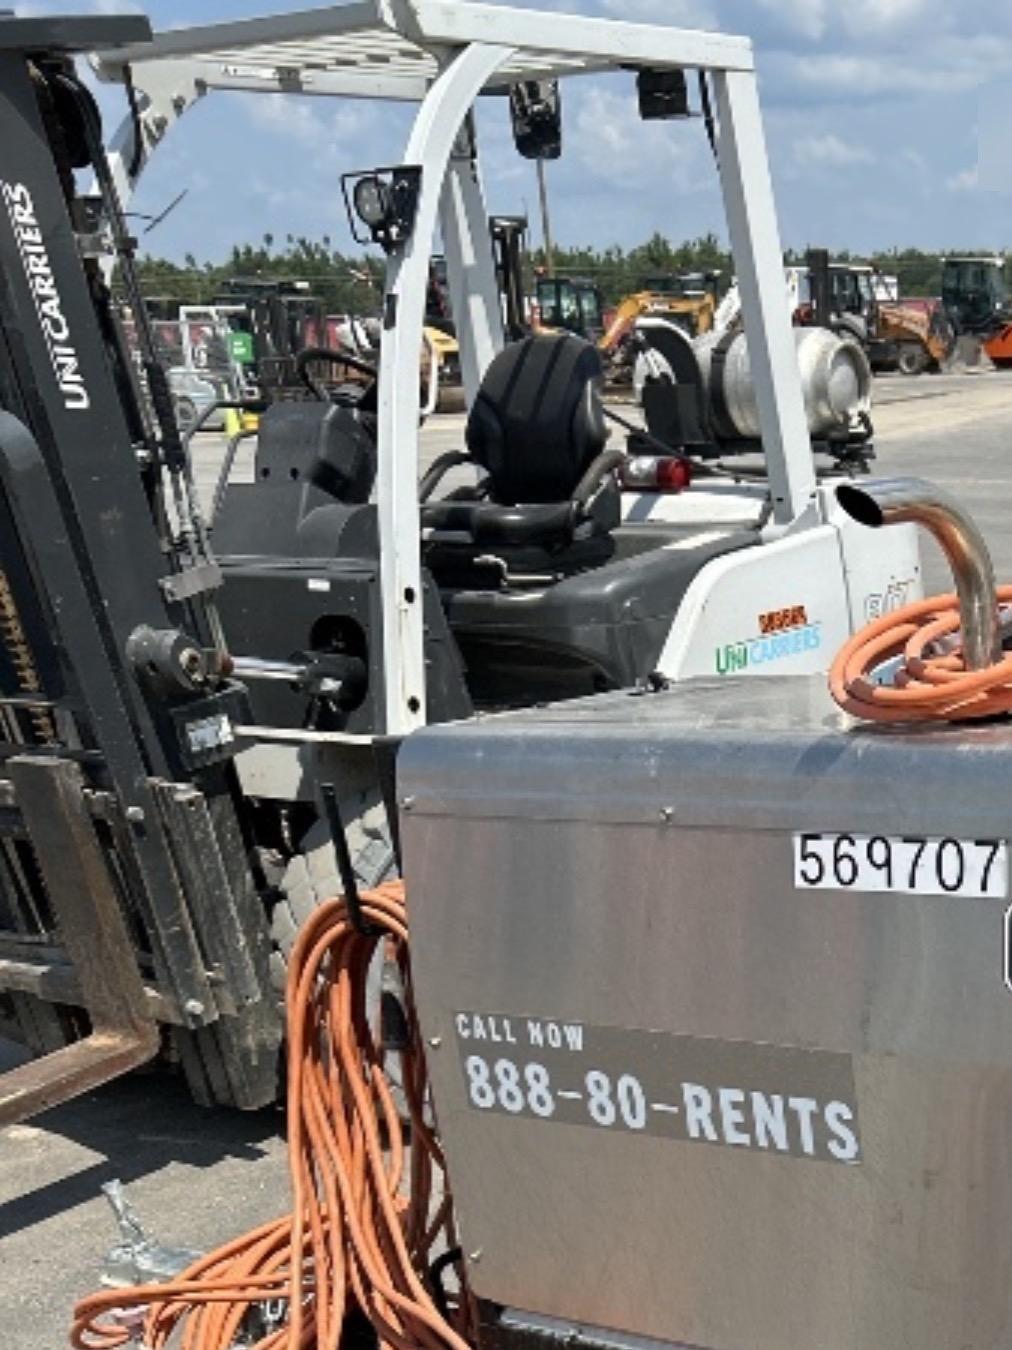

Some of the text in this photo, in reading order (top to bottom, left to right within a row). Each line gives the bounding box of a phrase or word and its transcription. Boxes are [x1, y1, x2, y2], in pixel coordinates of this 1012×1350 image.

[800, 834, 1001, 892] 569707
[455, 1012, 583, 1051] CALL NOW
[466, 1055, 859, 1159] 888-80-RENTS
